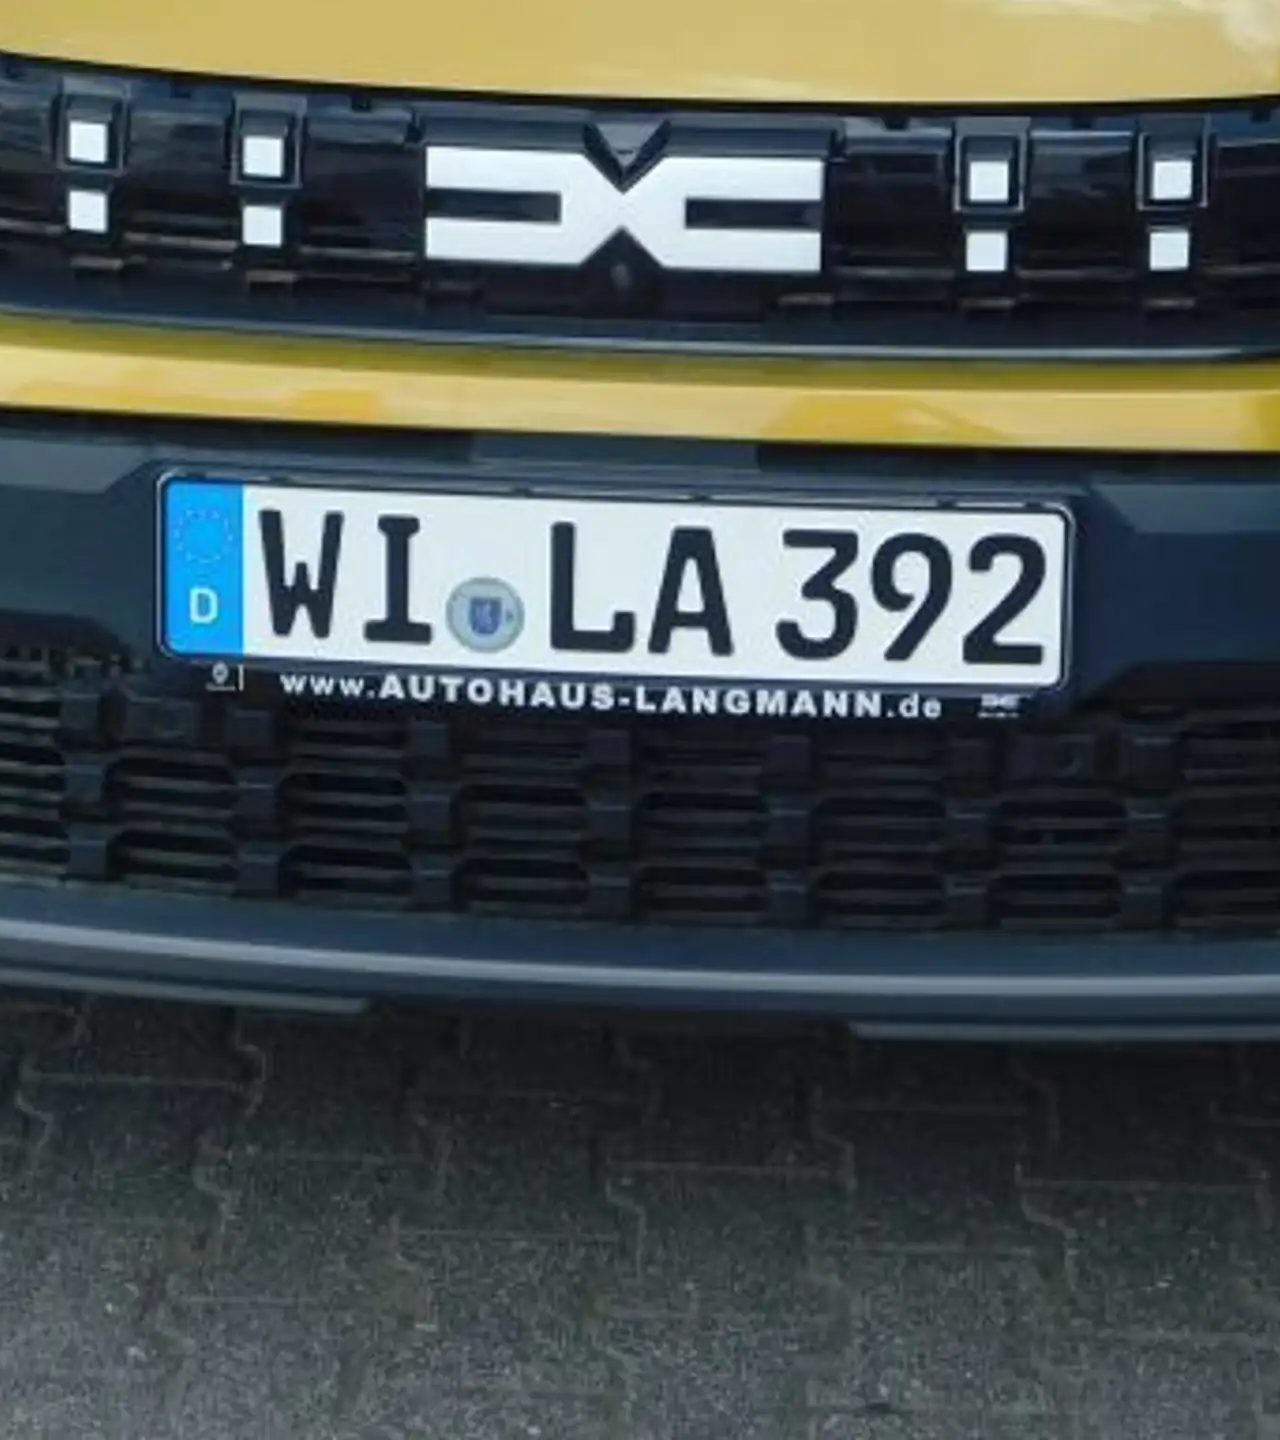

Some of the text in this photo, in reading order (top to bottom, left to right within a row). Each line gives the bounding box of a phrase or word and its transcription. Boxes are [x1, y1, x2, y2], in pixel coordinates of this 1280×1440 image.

[188, 586, 218, 624] D
[258, 508, 1047, 665] WI LA 392
[279, 673, 943, 719] www.AUTOHAUS-LANGMANN.de
